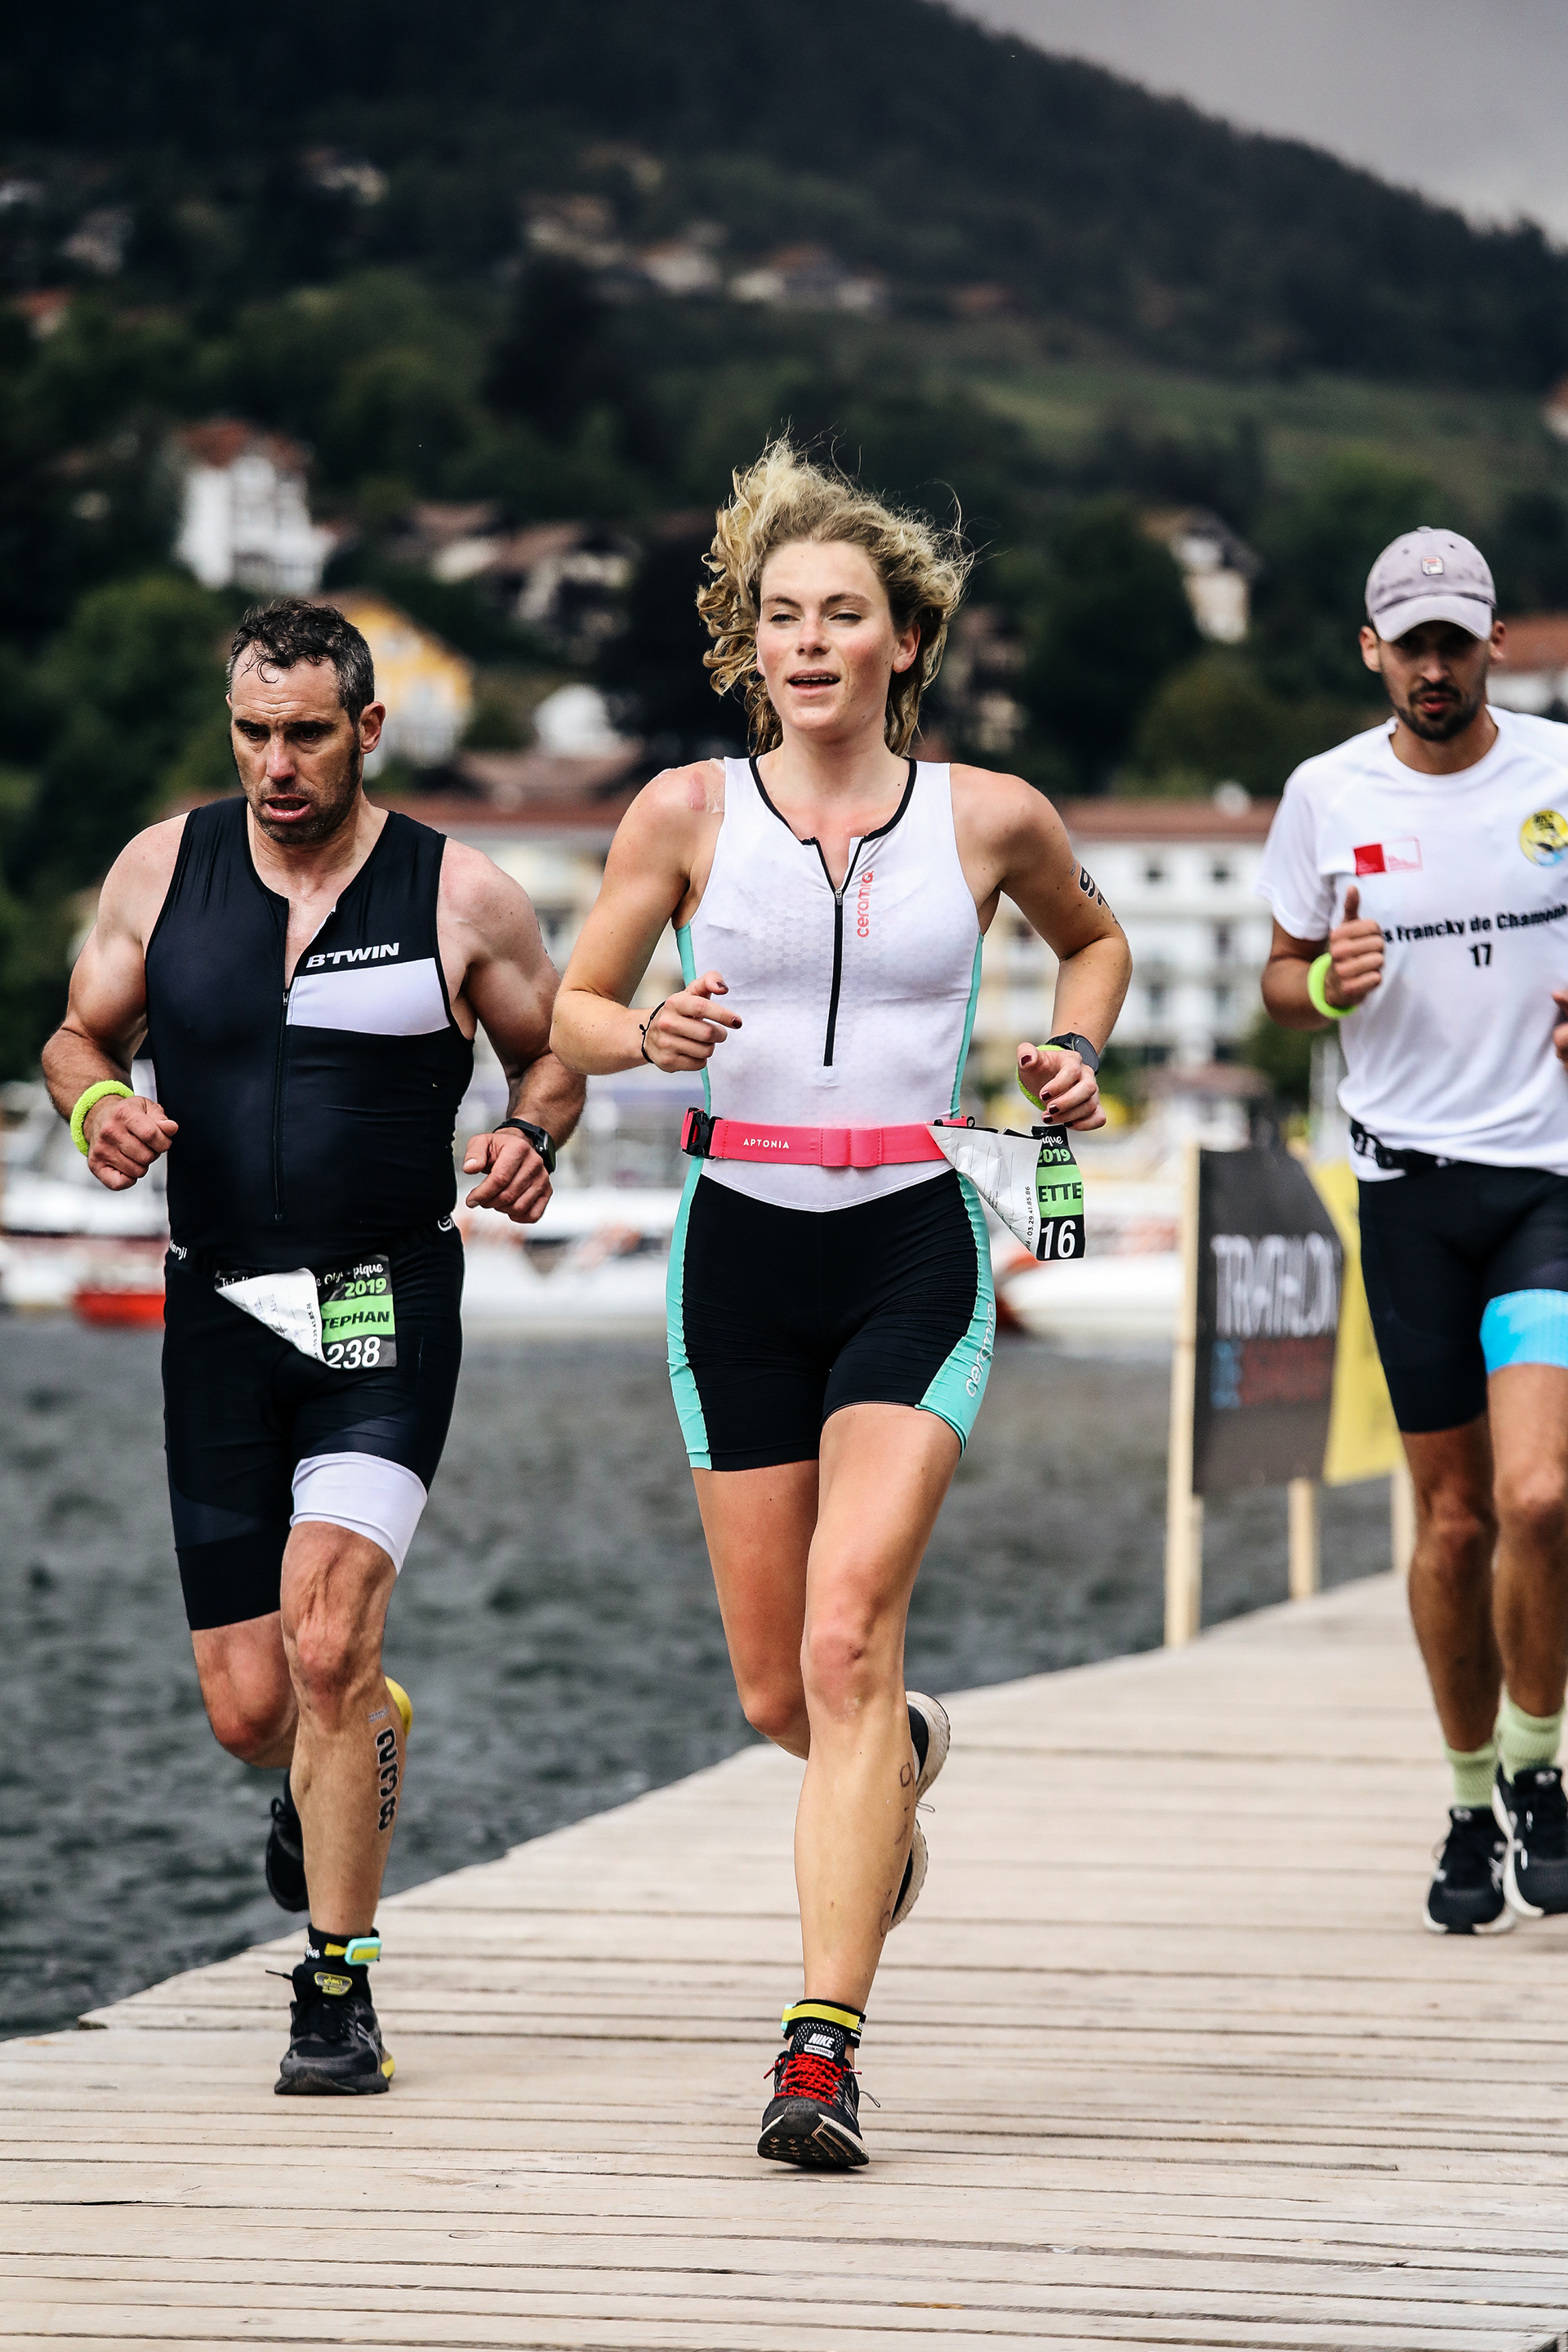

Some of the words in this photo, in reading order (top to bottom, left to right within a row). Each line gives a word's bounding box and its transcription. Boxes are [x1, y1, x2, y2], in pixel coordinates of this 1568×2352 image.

[1470, 915, 1492, 932] de
[1468, 942, 1492, 967] 17
[743, 1138, 790, 1149] APTONIA
[1038, 1182, 1082, 1203] ETTE
[1040, 1219, 1076, 1259] 16
[345, 1276, 387, 1297] 2019
[327, 1336, 381, 1370] 238
[376, 1726, 399, 1832] 238
[808, 2033, 835, 2048] NIKE
